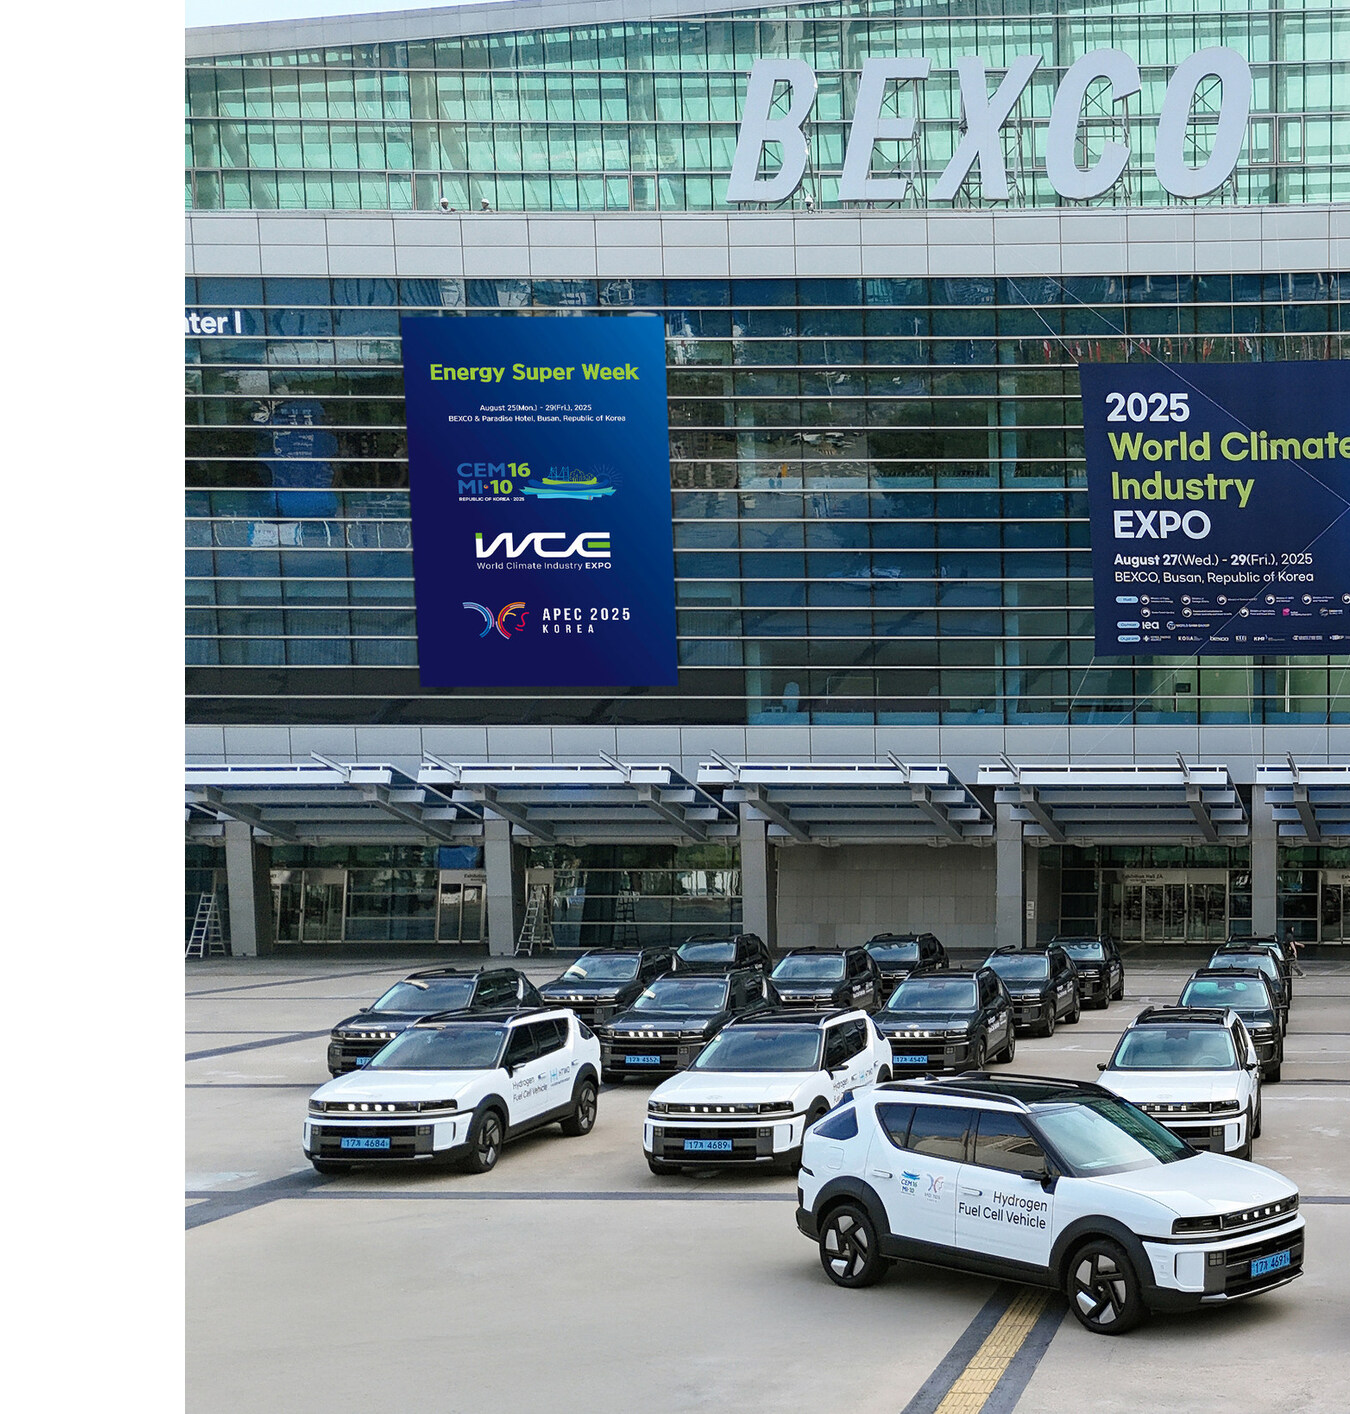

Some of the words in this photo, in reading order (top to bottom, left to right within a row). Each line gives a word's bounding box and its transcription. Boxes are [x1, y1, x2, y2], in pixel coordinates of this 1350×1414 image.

[725, 45, 1254, 204] BEXCO
[430, 363, 505, 382] Energy
[512, 363, 575, 382] Super
[582, 363, 640, 381] Week
[480, 404, 506, 412] August
[507, 404, 538, 412] 25(Mon.)
[1105, 392, 1191, 423] 2025
[515, 415, 535, 423] Hotel,
[563, 414, 594, 423] Republic
[596, 414, 603, 422] of
[605, 414, 626, 422] Korea
[1108, 431, 1211, 462] World
[1111, 471, 1254, 508] Industry
[1113, 510, 1212, 540] EXPO
[477, 562, 503, 570] World
[506, 562, 542, 570] Climate
[544, 562, 582, 571] Industry
[1114, 554, 1160, 568] August
[1163, 554, 1220, 567] 27(Wed.)
[1230, 554, 1279, 567] 29(Fri.),
[1281, 553, 1313, 565] 2025
[1115, 572, 1161, 584] BEXCO,
[1163, 572, 1205, 585] Busan,
[1207, 571, 1260, 586] Republic
[1263, 571, 1276, 583] of
[1278, 571, 1314, 582] Korea
[542, 608, 582, 621] APEC
[590, 608, 630, 621] 2025
[542, 624, 594, 633] KOREA
[707, 1141, 728, 1149] 4689
[993, 1191, 1048, 1212] Hydrogen
[959, 1202, 981, 1217] Fuel
[983, 1206, 1004, 1221] Cell
[1006, 1211, 1046, 1229] Vehicle
[1270, 1255, 1287, 1267] 4691
